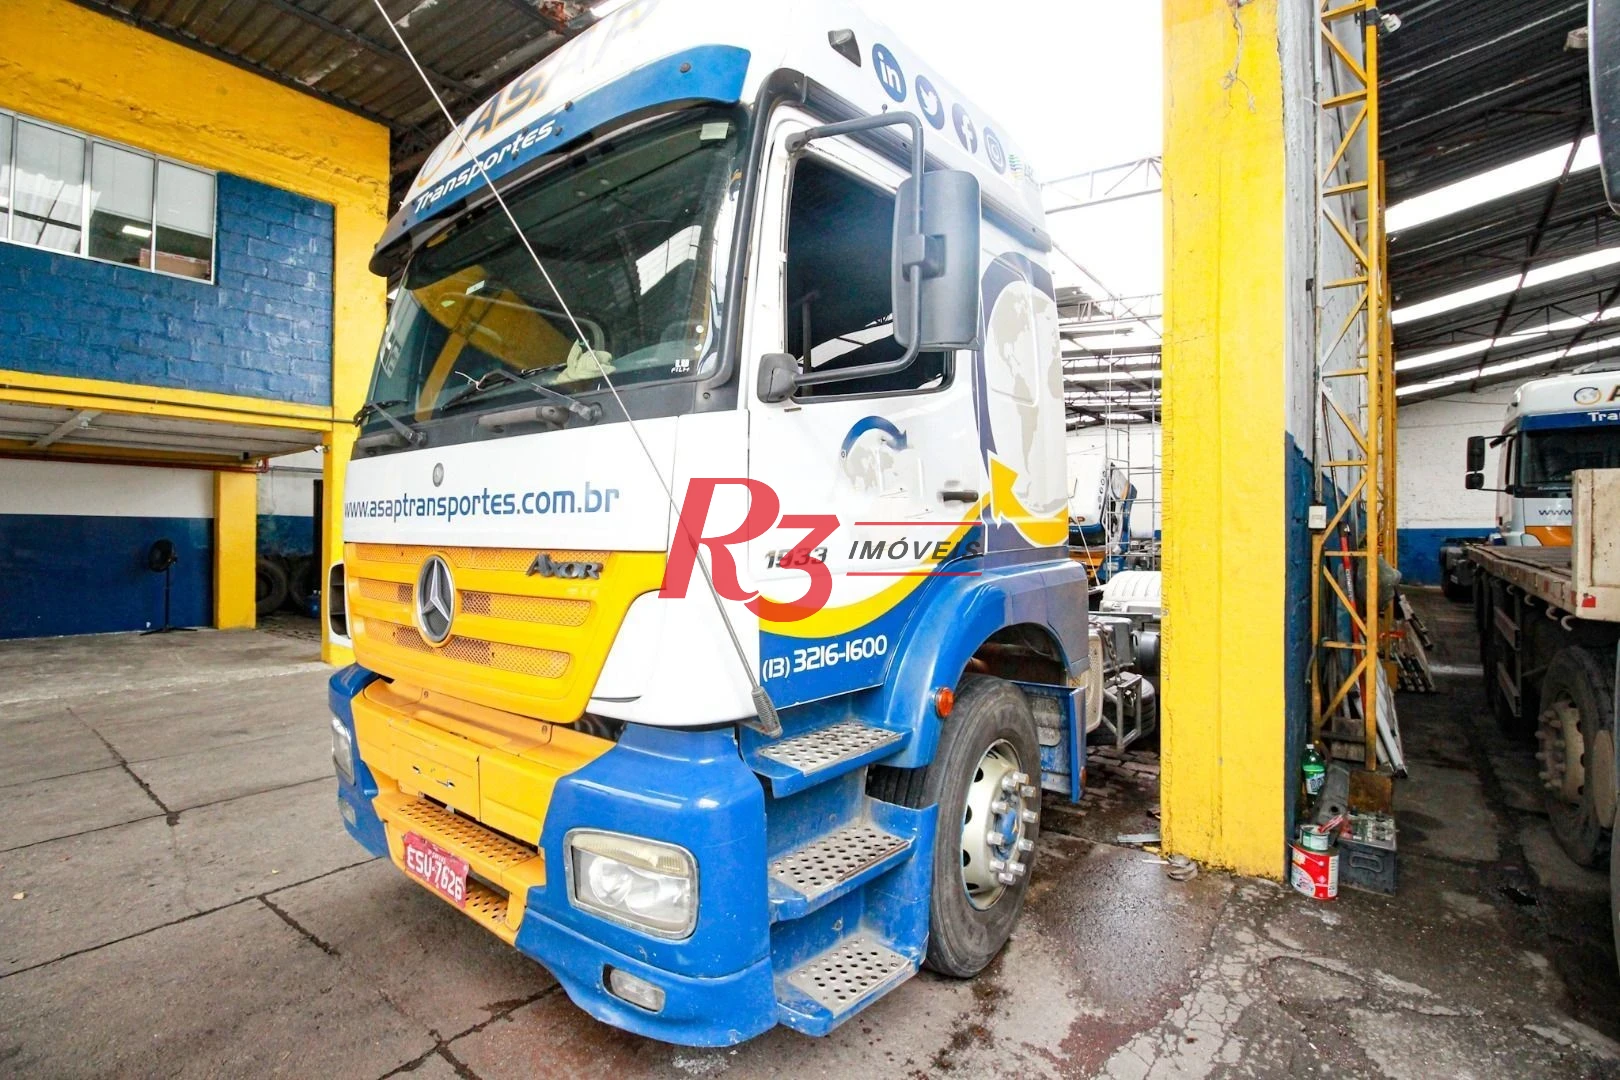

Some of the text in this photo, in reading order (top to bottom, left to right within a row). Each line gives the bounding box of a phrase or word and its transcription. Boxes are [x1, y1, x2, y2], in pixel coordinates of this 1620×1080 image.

[414, 117, 555, 214] Transportes
[1588, 411, 1620, 422] Tra
[344, 481, 619, 523] www.asaptransportes.com.br
[762, 635, 888, 682] (13) 3216-1600
[407, 845, 462, 901] ESU-7626
